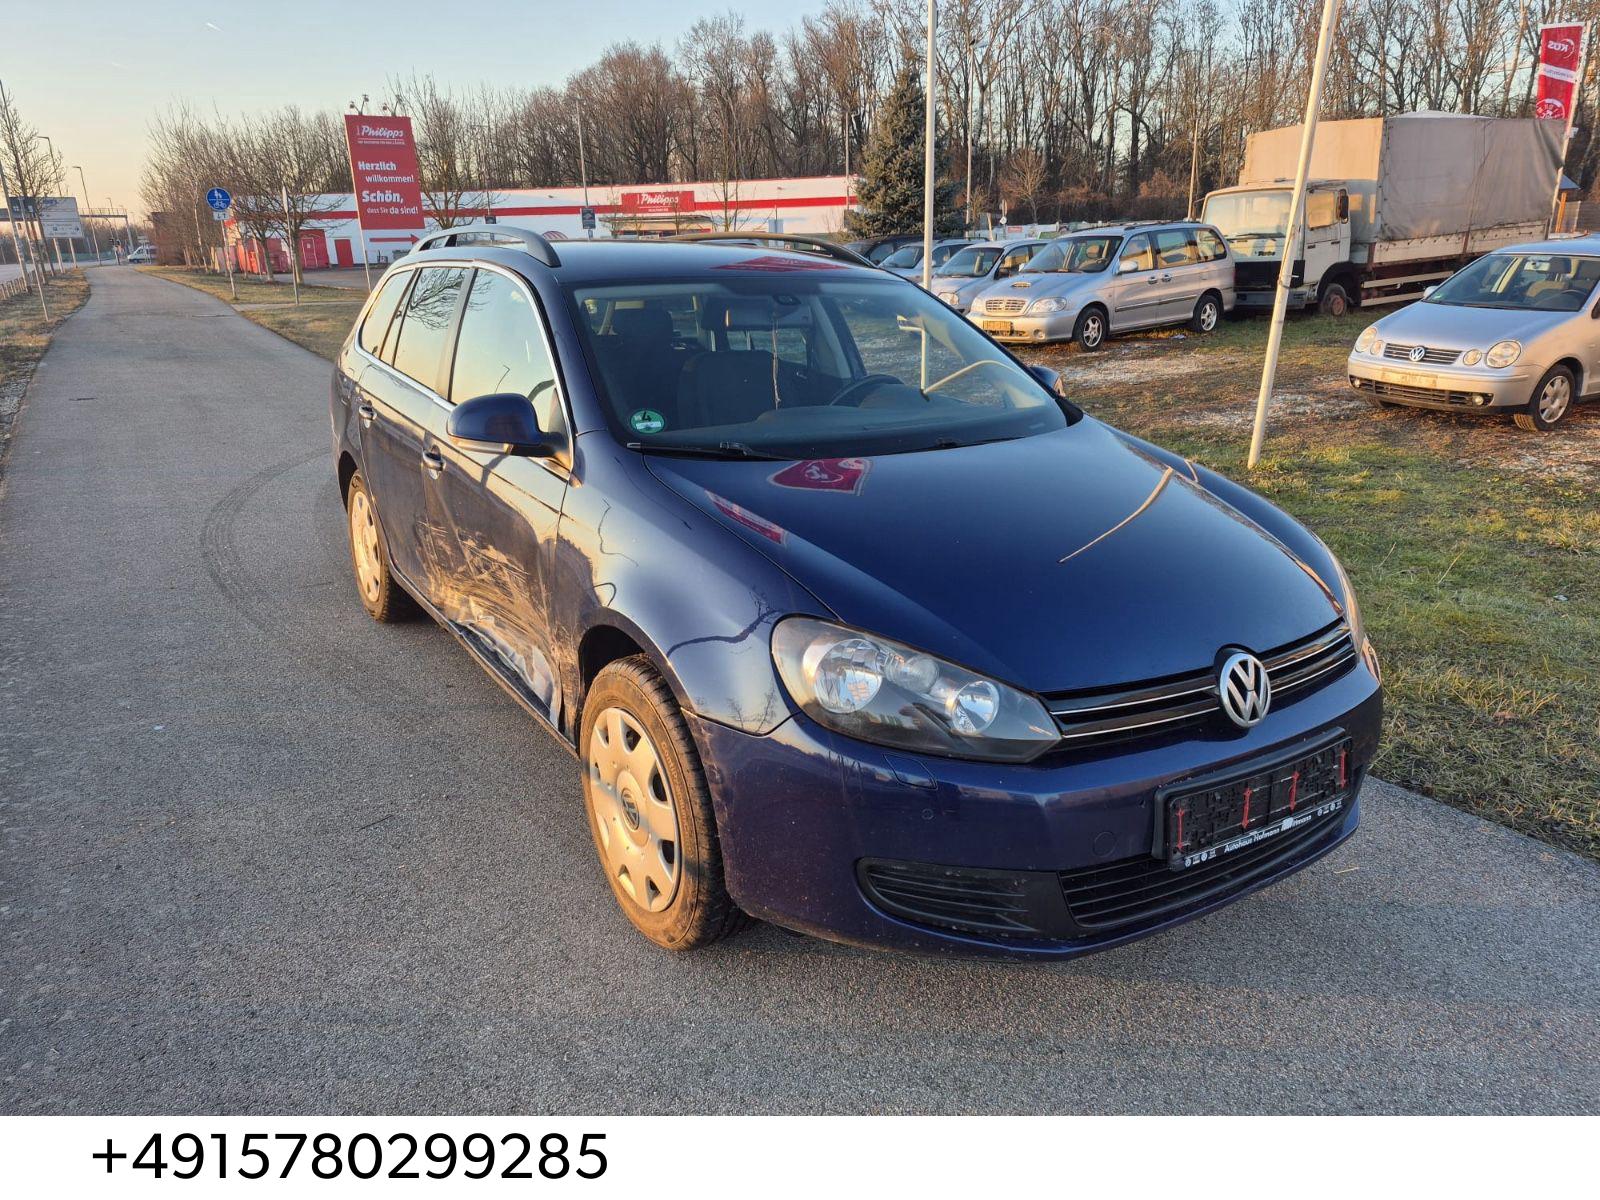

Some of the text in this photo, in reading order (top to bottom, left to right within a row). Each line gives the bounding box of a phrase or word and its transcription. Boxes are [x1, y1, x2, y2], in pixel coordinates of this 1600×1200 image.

[361, 125, 404, 138] Philipps
[358, 161, 397, 171] Herzlich
[365, 174, 414, 183] willkommen!
[361, 190, 404, 204] Schön,
[640, 193, 679, 205] Philipps
[389, 206, 399, 215] da
[400, 206, 419, 215] sind!
[642, 411, 652, 422] 4
[1224, 837, 1253, 853] Autohaus
